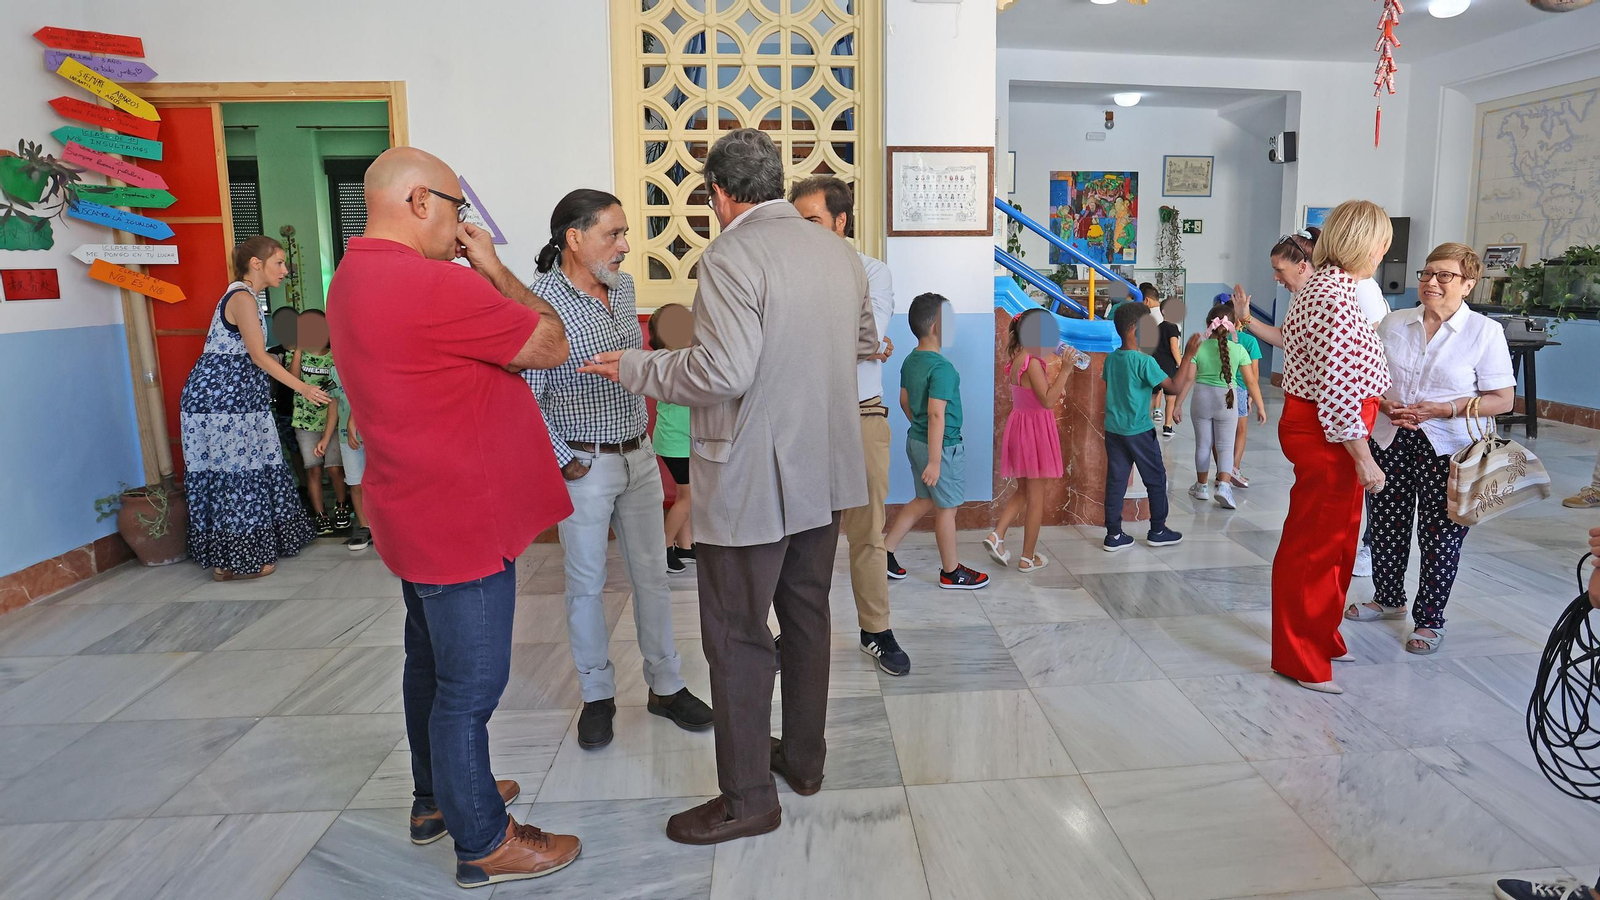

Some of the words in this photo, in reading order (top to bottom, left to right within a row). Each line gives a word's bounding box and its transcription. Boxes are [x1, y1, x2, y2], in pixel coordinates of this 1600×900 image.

[77, 70, 105, 88] SIEMPRE
[112, 90, 139, 109] ABRAZOS
[84, 129, 109, 139] CLASE
[131, 278, 145, 288] ES
